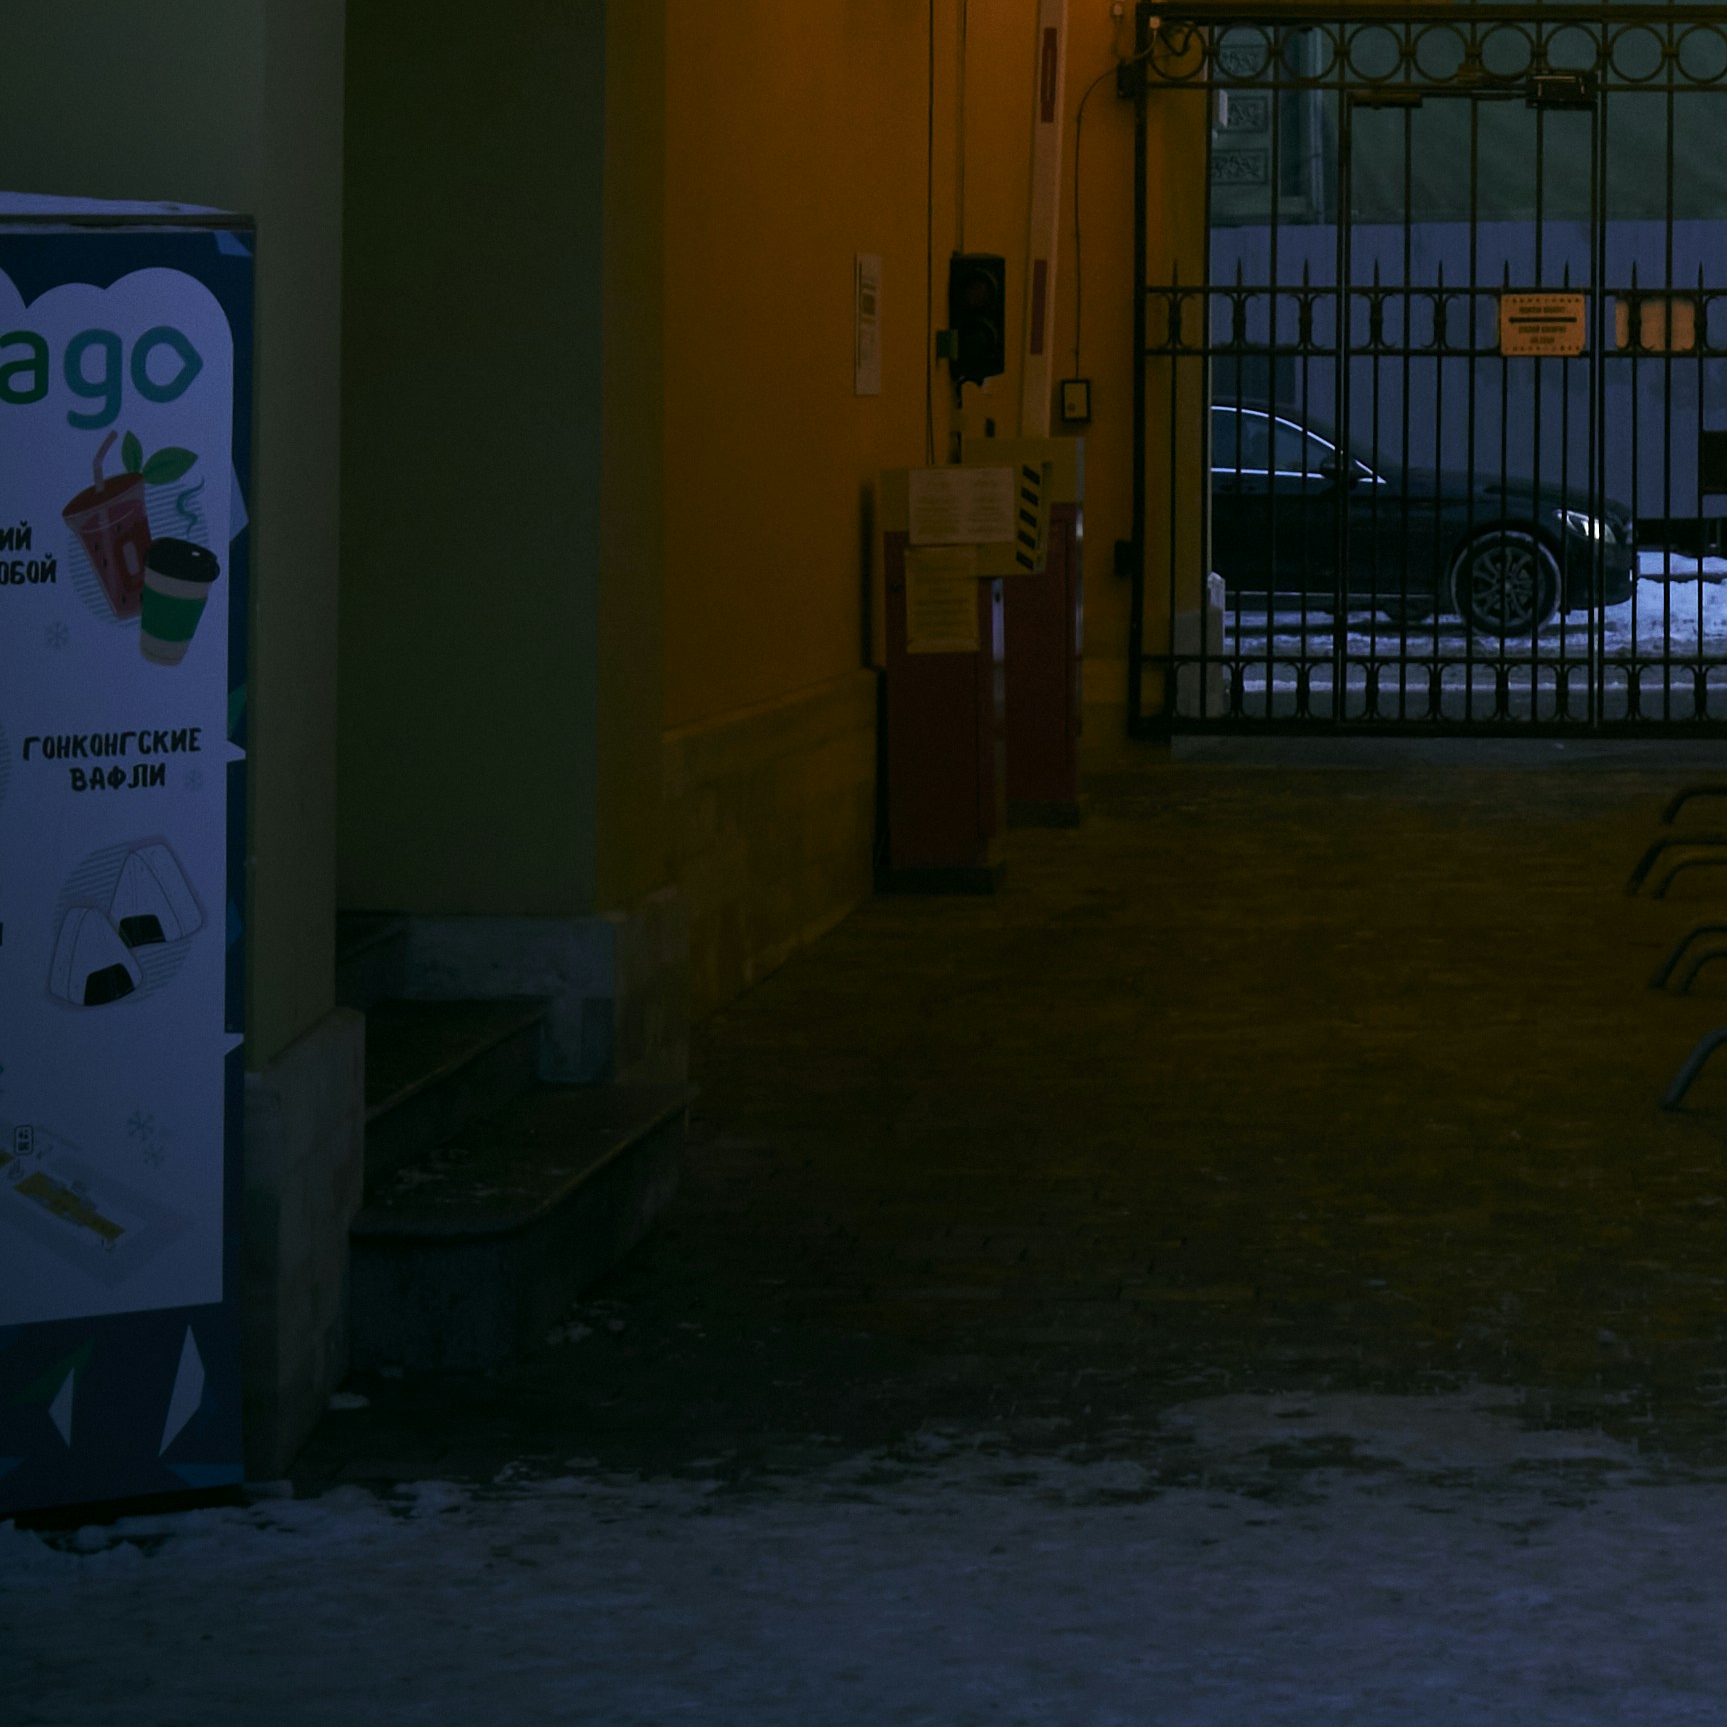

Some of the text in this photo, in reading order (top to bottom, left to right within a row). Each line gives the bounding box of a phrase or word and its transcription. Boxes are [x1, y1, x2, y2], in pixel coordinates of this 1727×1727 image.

[0, 326, 203, 430] ago
[0, 552, 57, 585] ОБОЙ
[23, 728, 201, 760] ГОНКОНГСКИЕ
[69, 763, 166, 791] ВАФЛИ
